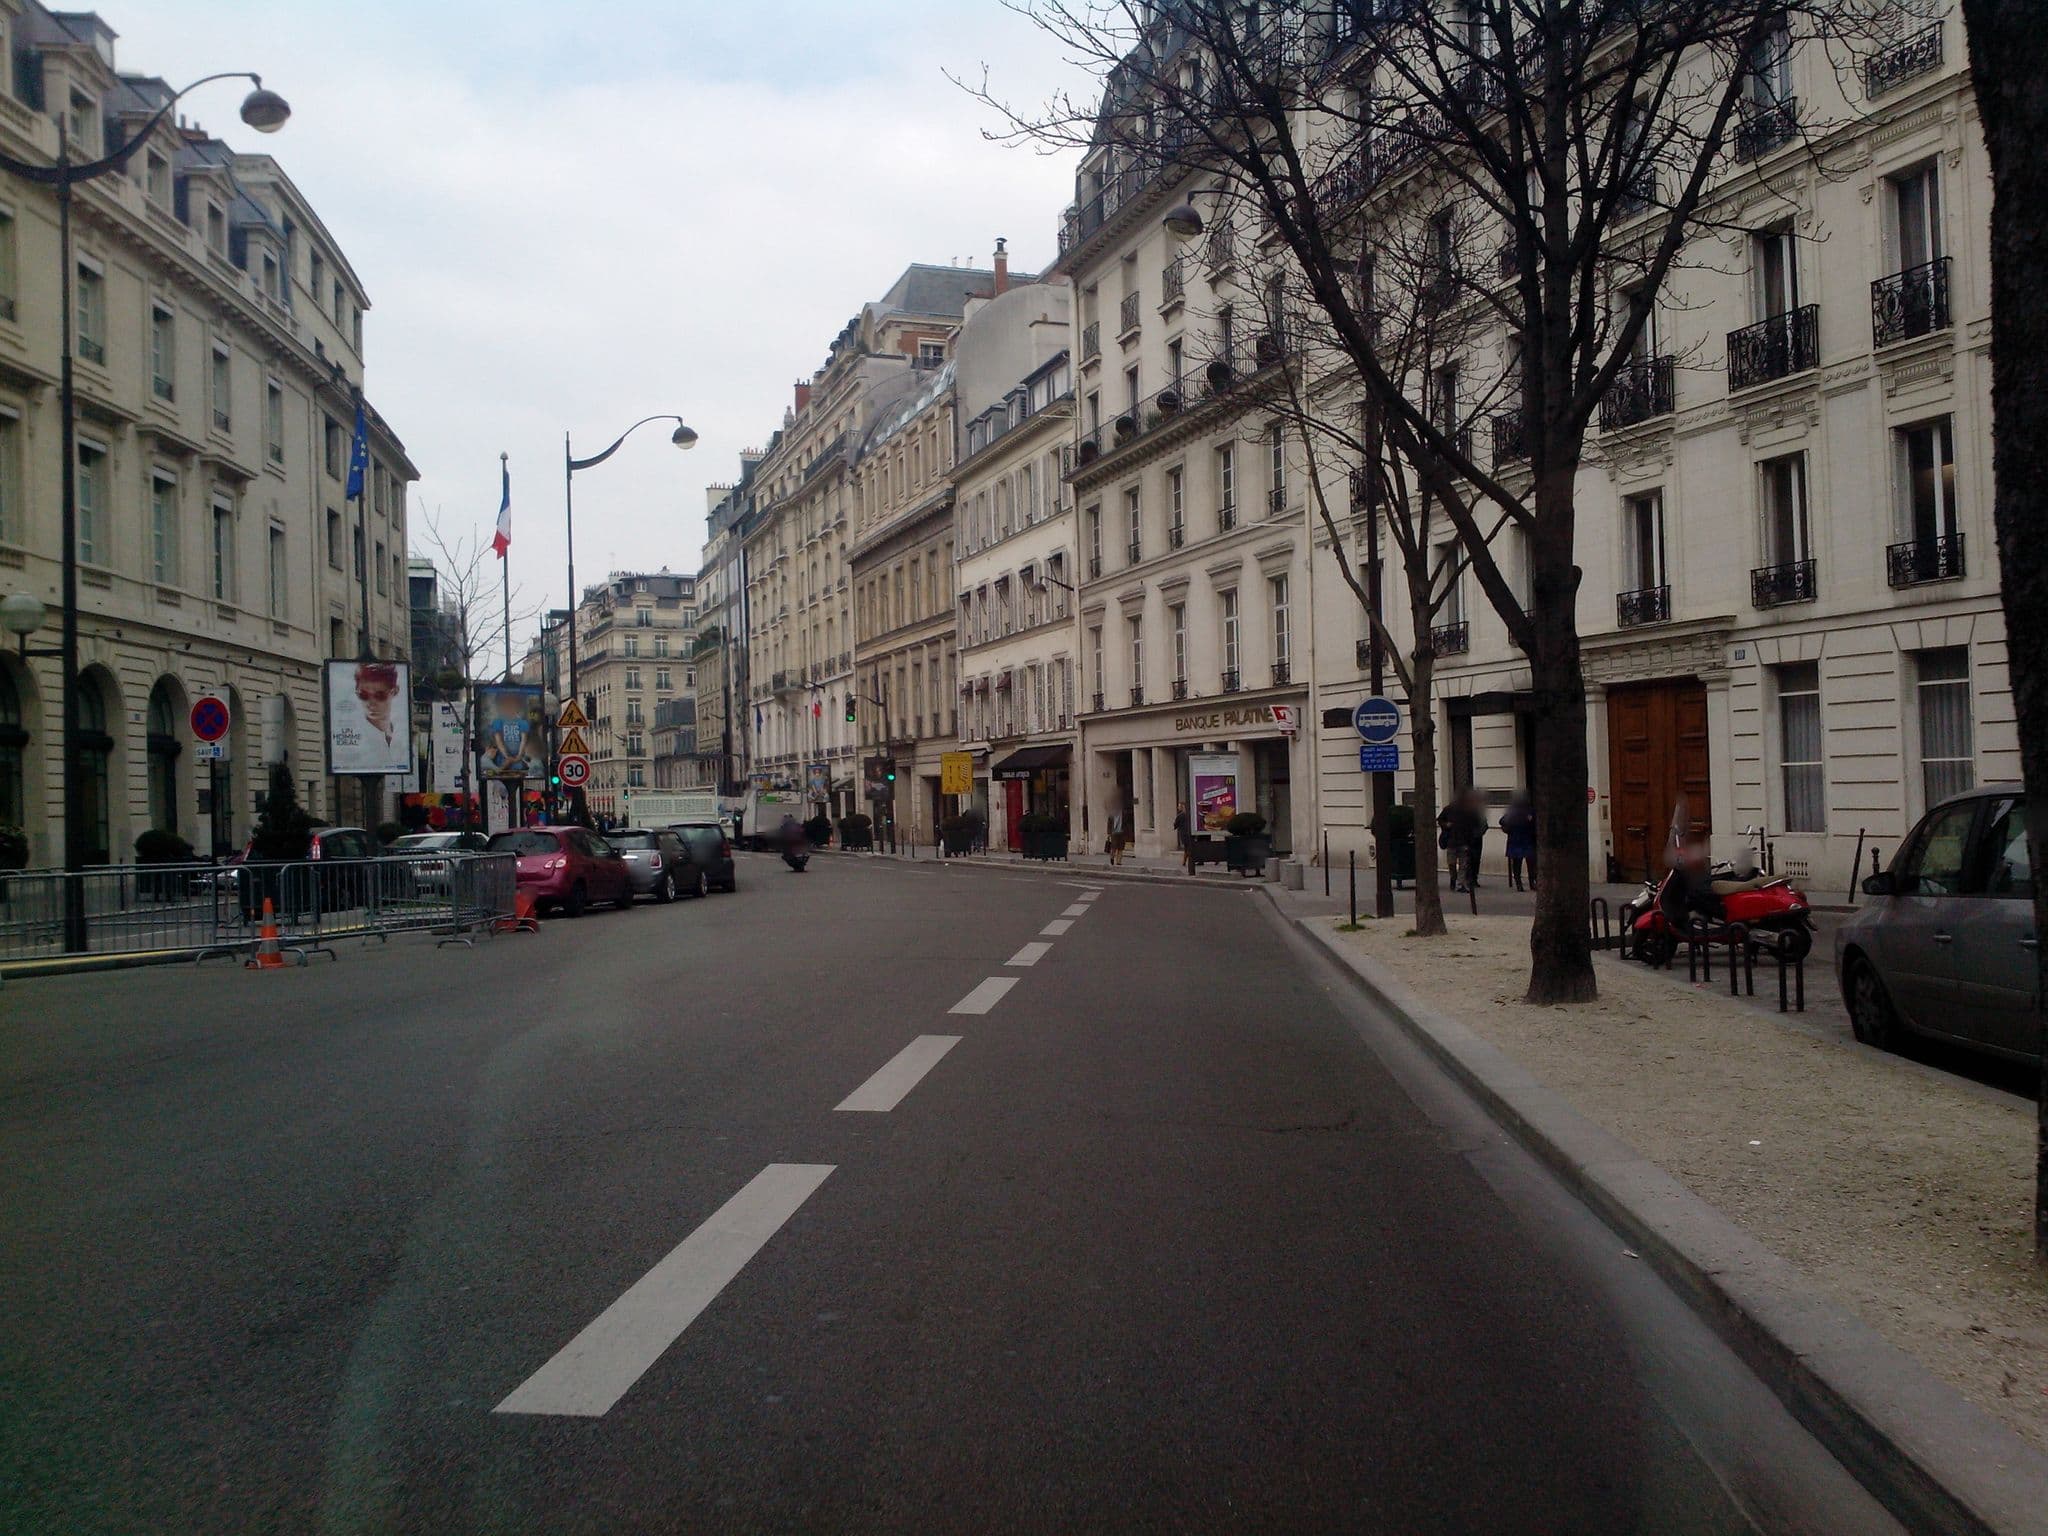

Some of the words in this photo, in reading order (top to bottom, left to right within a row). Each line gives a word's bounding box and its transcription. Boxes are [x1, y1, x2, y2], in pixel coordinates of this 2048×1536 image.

[1175, 714, 1220, 732] BANQUE
[1223, 707, 1274, 727] PALATINE
[503, 724, 520, 736] BIG
[565, 764, 584, 777] 30
